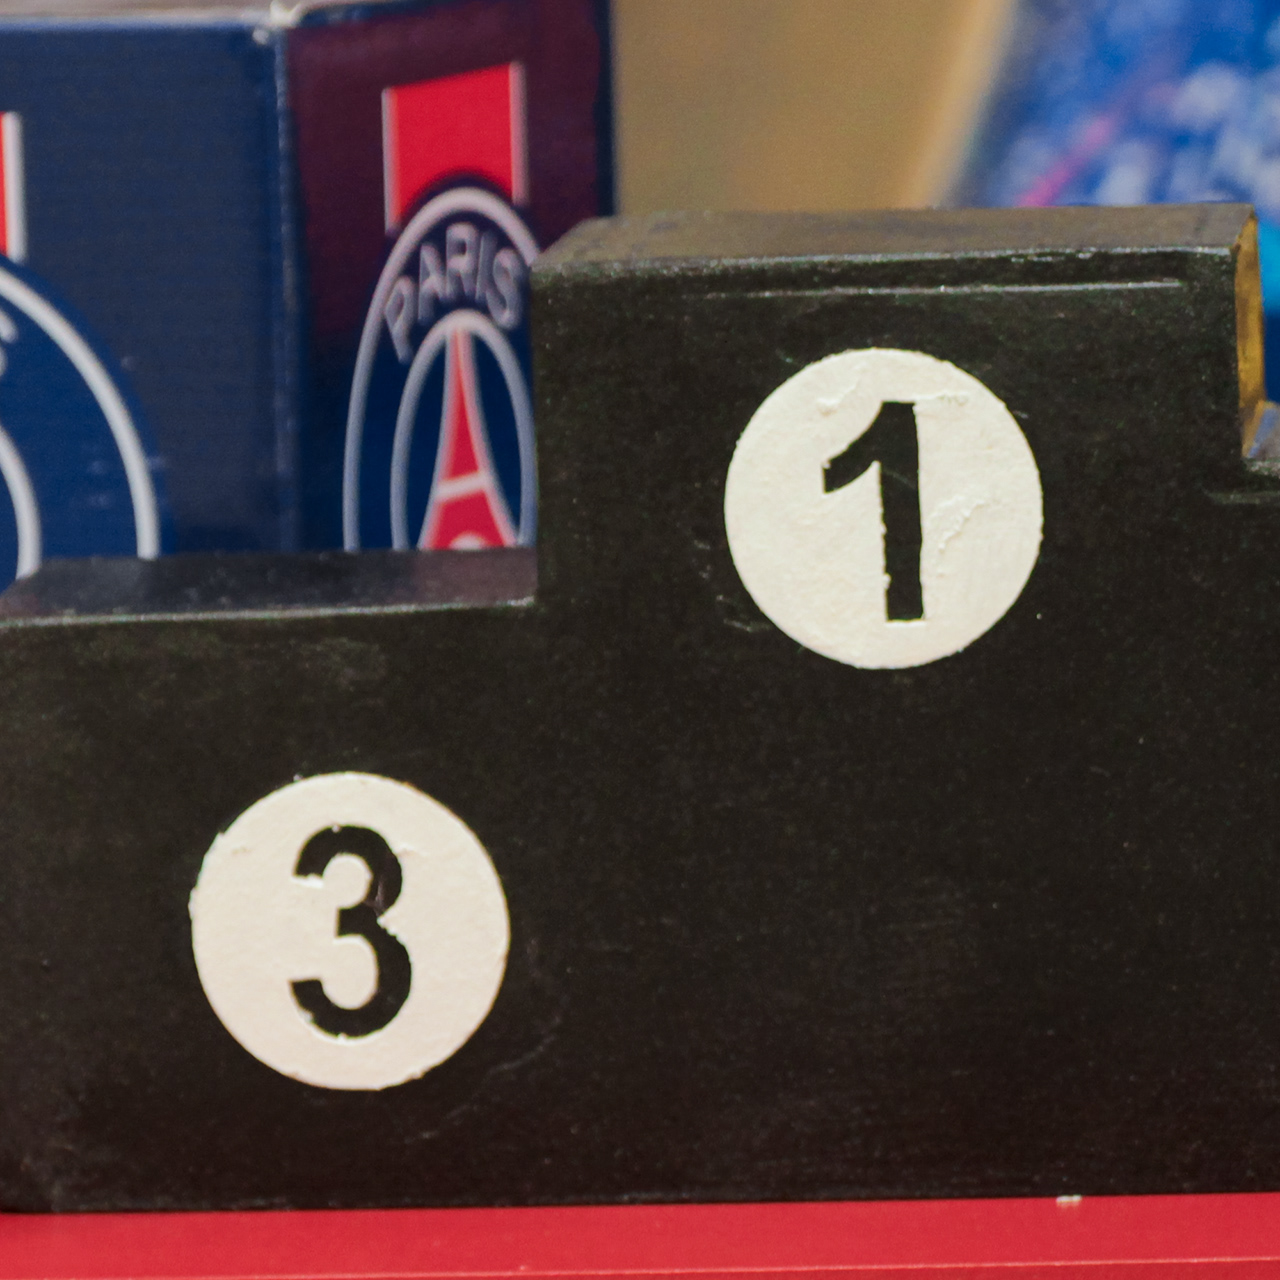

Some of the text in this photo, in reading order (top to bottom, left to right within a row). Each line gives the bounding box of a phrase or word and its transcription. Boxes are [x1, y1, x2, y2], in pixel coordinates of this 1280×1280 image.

[384, 221, 524, 366] PARIS
[823, 402, 924, 621] 1
[291, 825, 412, 1037] 3
